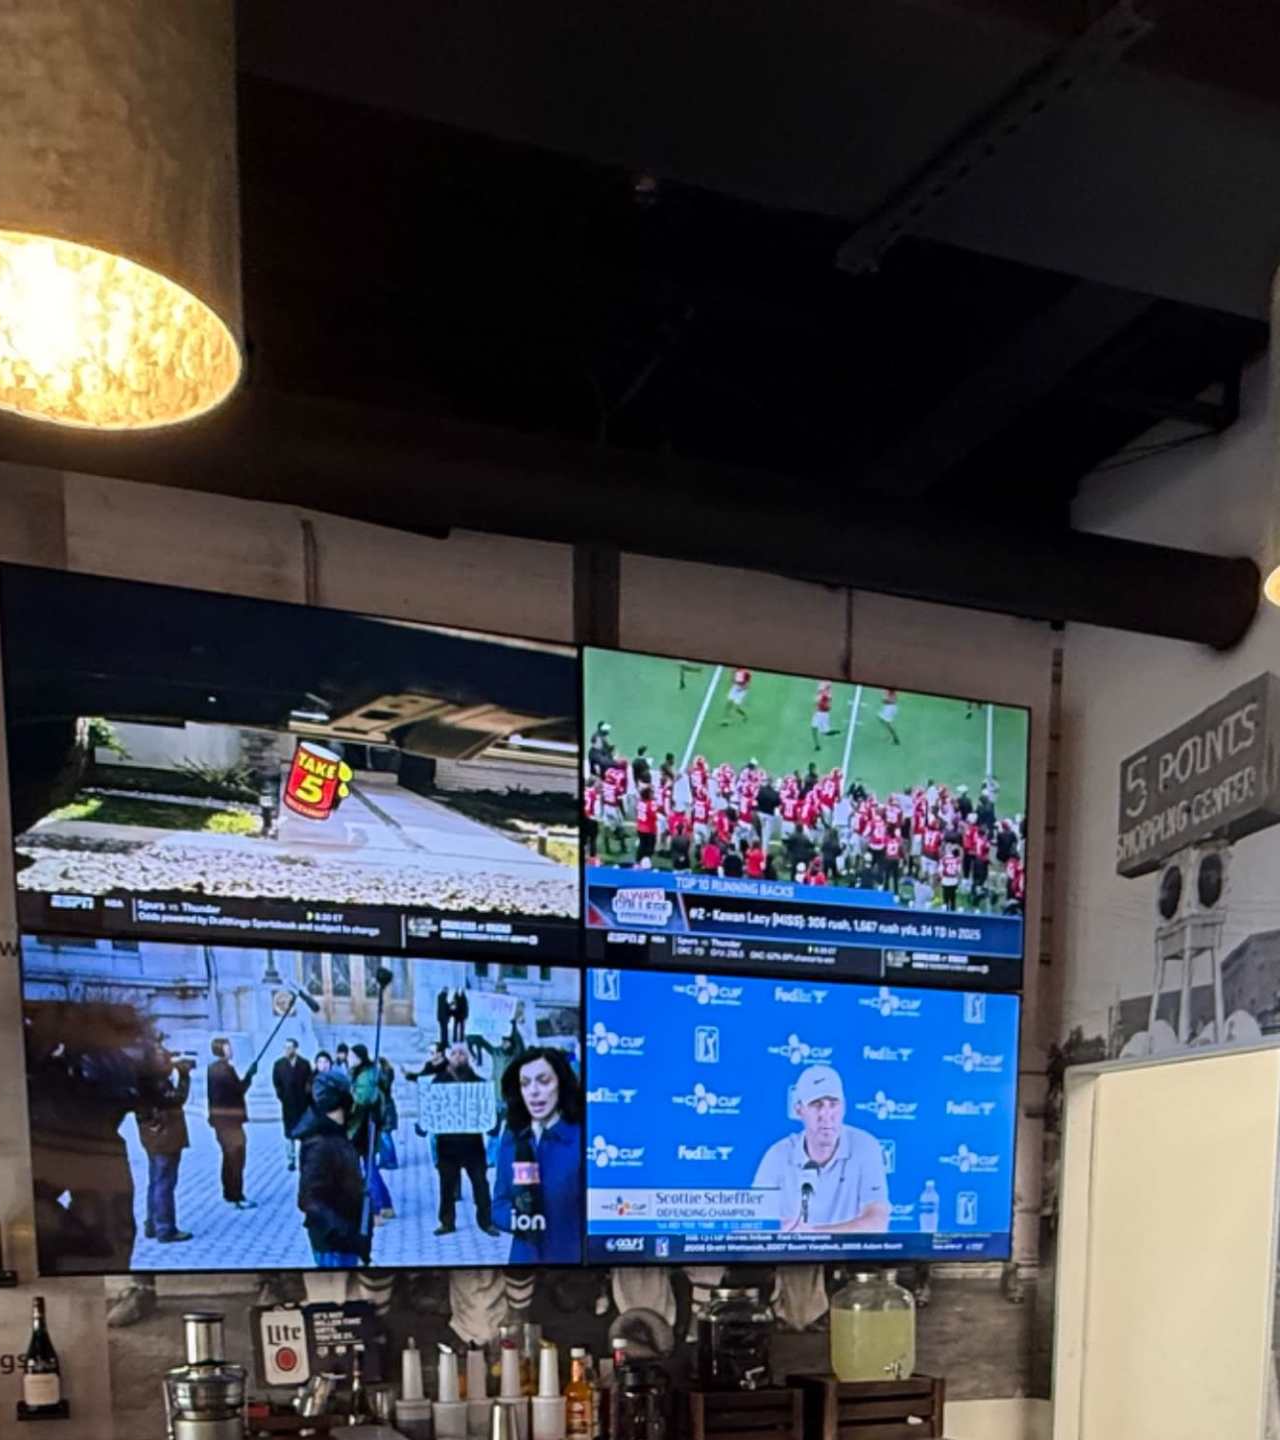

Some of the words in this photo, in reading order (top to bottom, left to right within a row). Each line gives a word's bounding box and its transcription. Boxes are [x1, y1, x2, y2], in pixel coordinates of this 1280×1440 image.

[297, 752, 338, 780] TAKE
[1125, 754, 1147, 818] 5
[1158, 703, 1261, 793] POINTS
[295, 773, 324, 804] 5
[511, 1209, 546, 1231] ion
[267, 1324, 302, 1346] Lite
